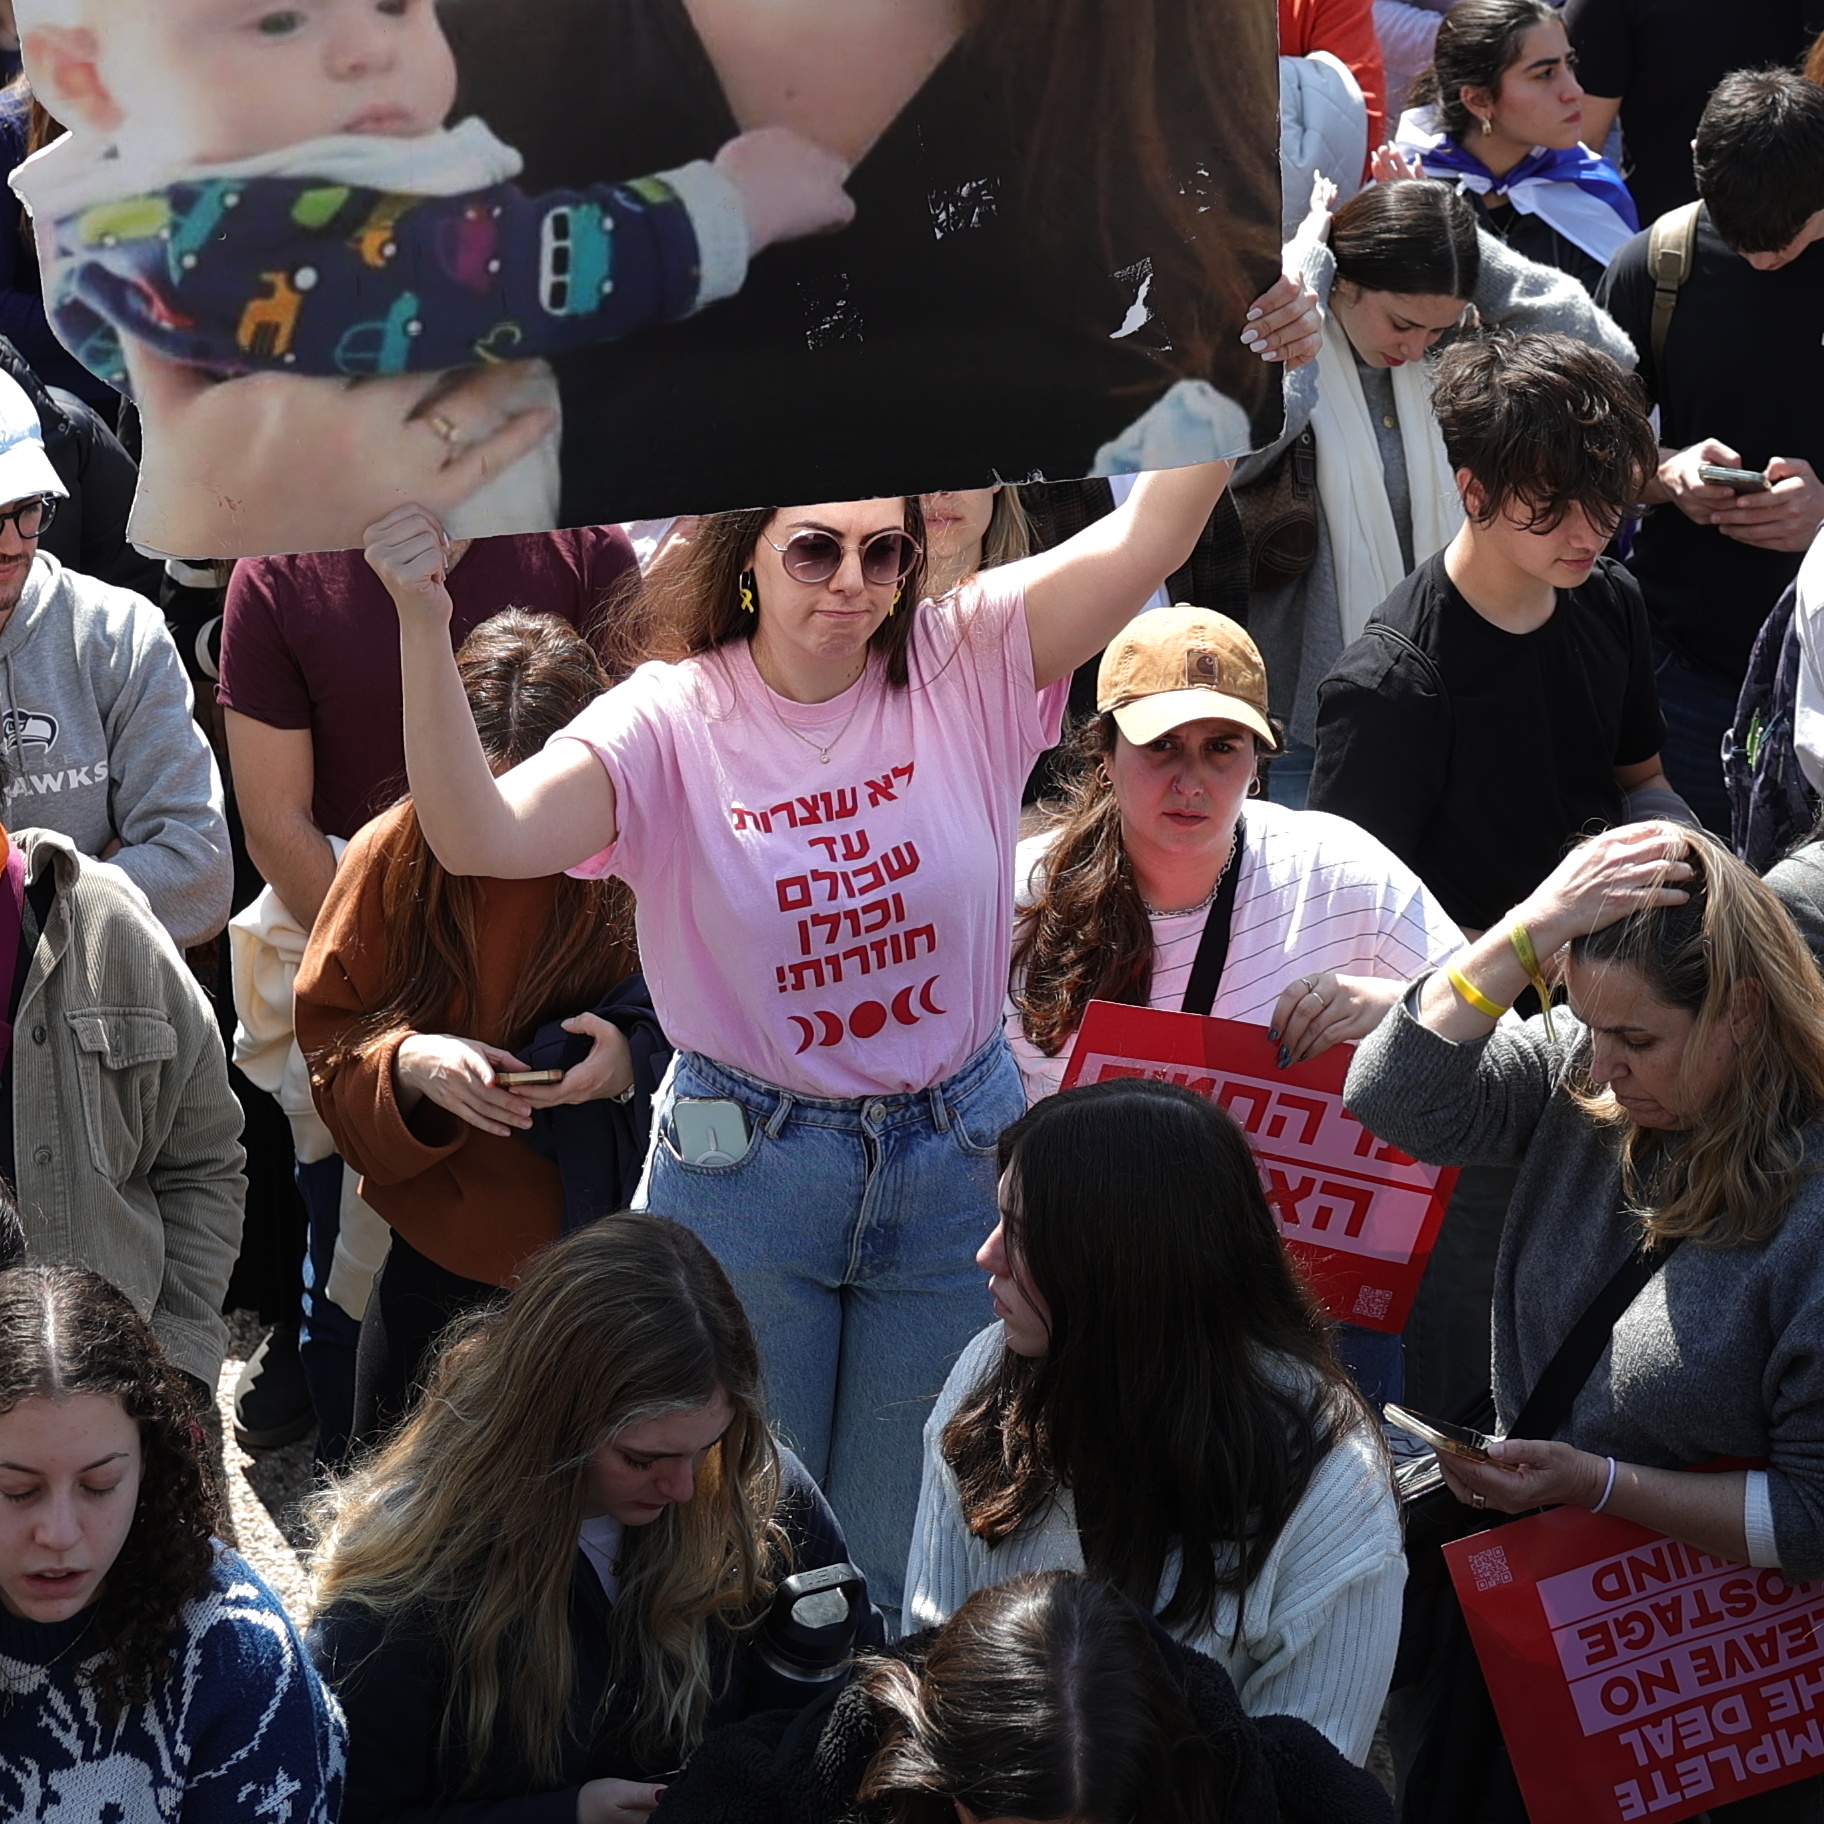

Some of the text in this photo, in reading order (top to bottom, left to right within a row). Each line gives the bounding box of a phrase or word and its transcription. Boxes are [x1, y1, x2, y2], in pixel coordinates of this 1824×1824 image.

[2, 759, 108, 805] AWKS
[731, 760, 915, 833] לא עוצרות
[775, 840, 920, 912] שכולם
[808, 828, 871, 863] עד
[797, 892, 906, 955] וכולן
[776, 923, 936, 993] חוזרות!
[1591, 1537, 1750, 1603] HIND
[1600, 1658, 1682, 1716] NO
[1618, 1693, 1752, 1766] DEAL
